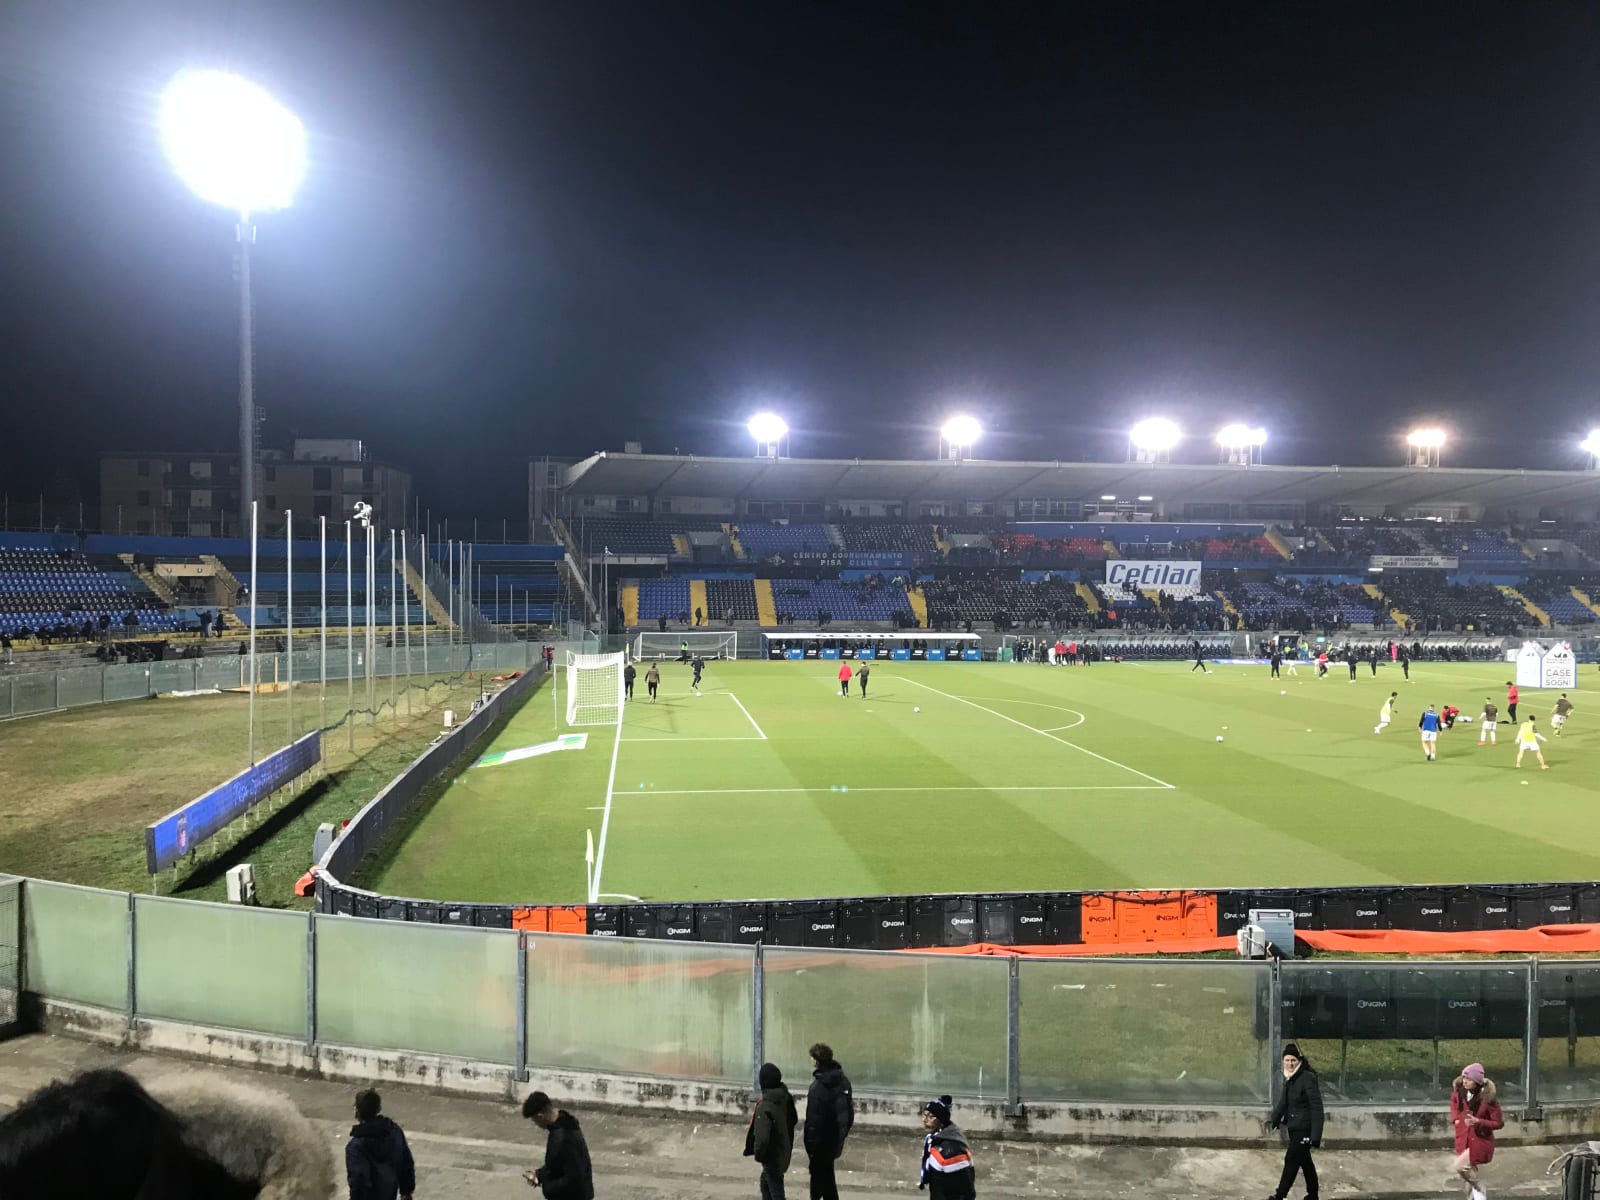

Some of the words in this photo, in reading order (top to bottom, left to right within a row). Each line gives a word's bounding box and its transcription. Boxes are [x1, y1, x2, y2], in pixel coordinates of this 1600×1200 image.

[1109, 564, 1198, 585] Cetilar
[1545, 669, 1572, 677] CASE
[816, 923, 835, 931] NGM
[887, 920, 905, 928] NGM
[671, 927, 691, 936] NGM
[744, 925, 764, 934] NGM
